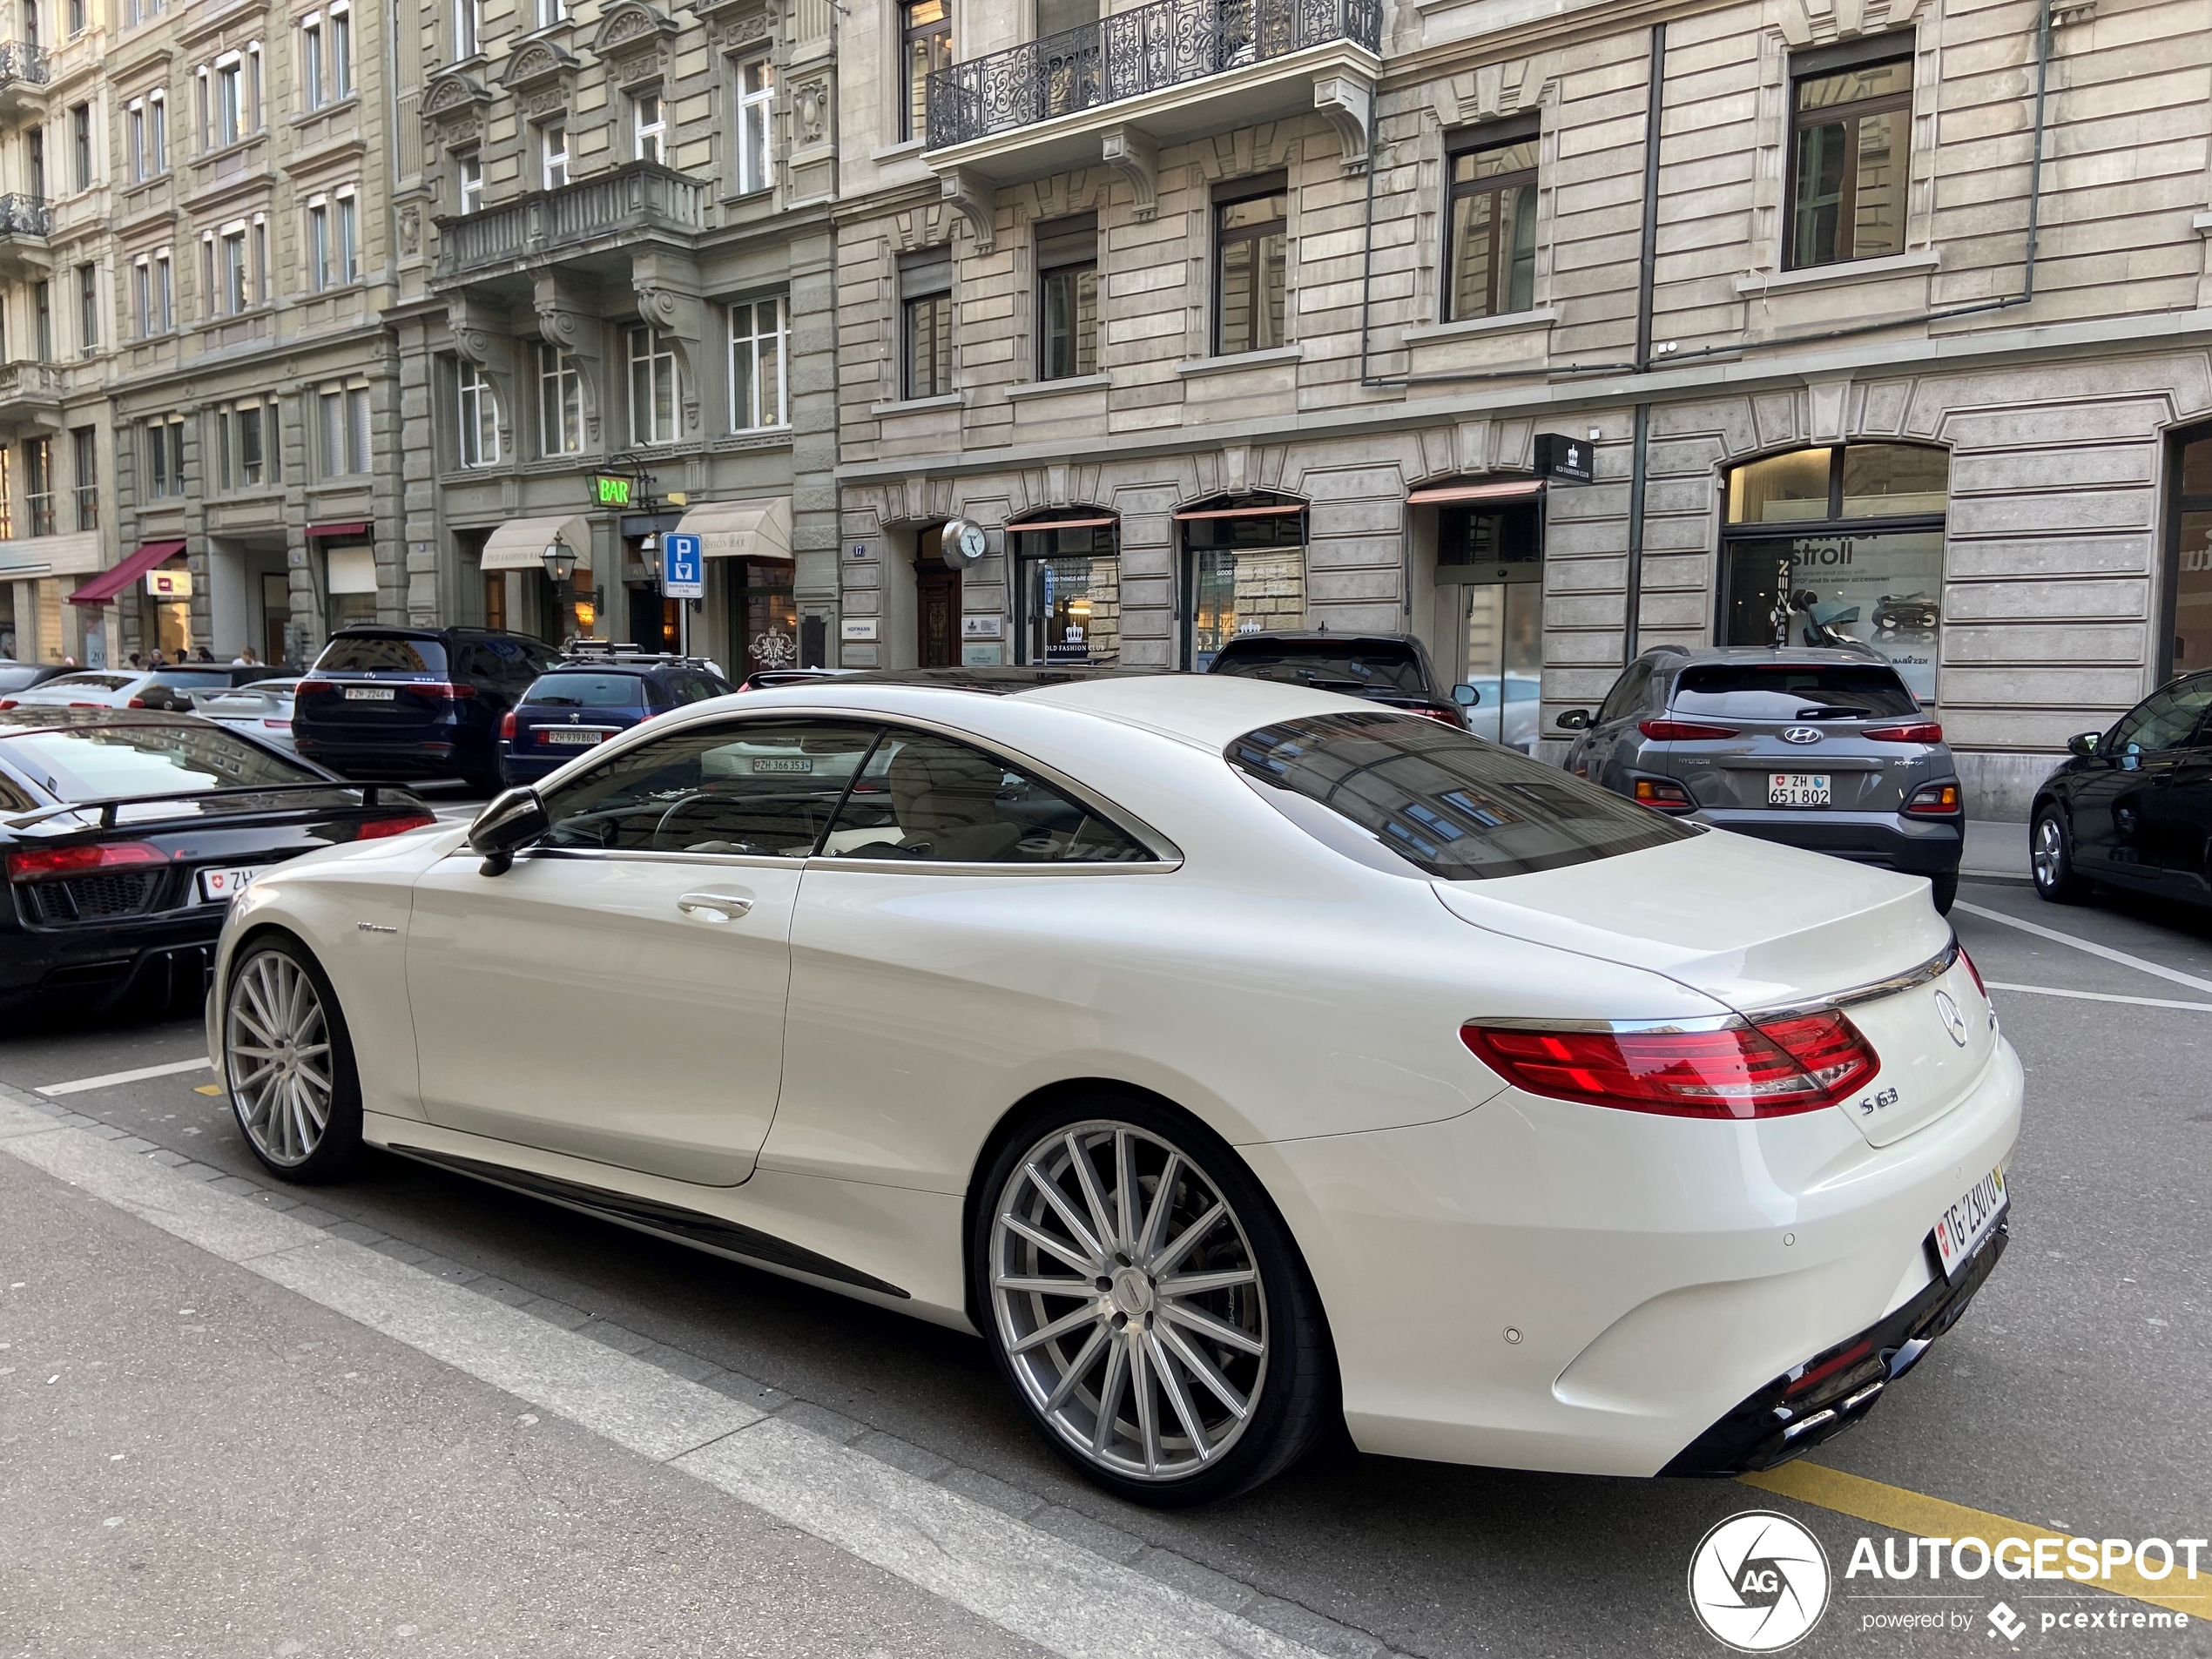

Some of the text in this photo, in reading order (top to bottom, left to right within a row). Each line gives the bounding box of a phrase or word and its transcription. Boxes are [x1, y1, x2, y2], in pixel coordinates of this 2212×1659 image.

[599, 479, 629, 502] BAR
[677, 538, 691, 562] P
[704, 539, 745, 550] SHION BAR
[855, 546, 862, 555] 17
[488, 554, 500, 563] OLD
[501, 551, 528, 561] FASHION
[1791, 541, 1853, 566] stroll
[1792, 775, 1808, 787] ZH
[1770, 788, 1829, 804] 651 802
[1858, 1087, 1898, 1116] S 63
